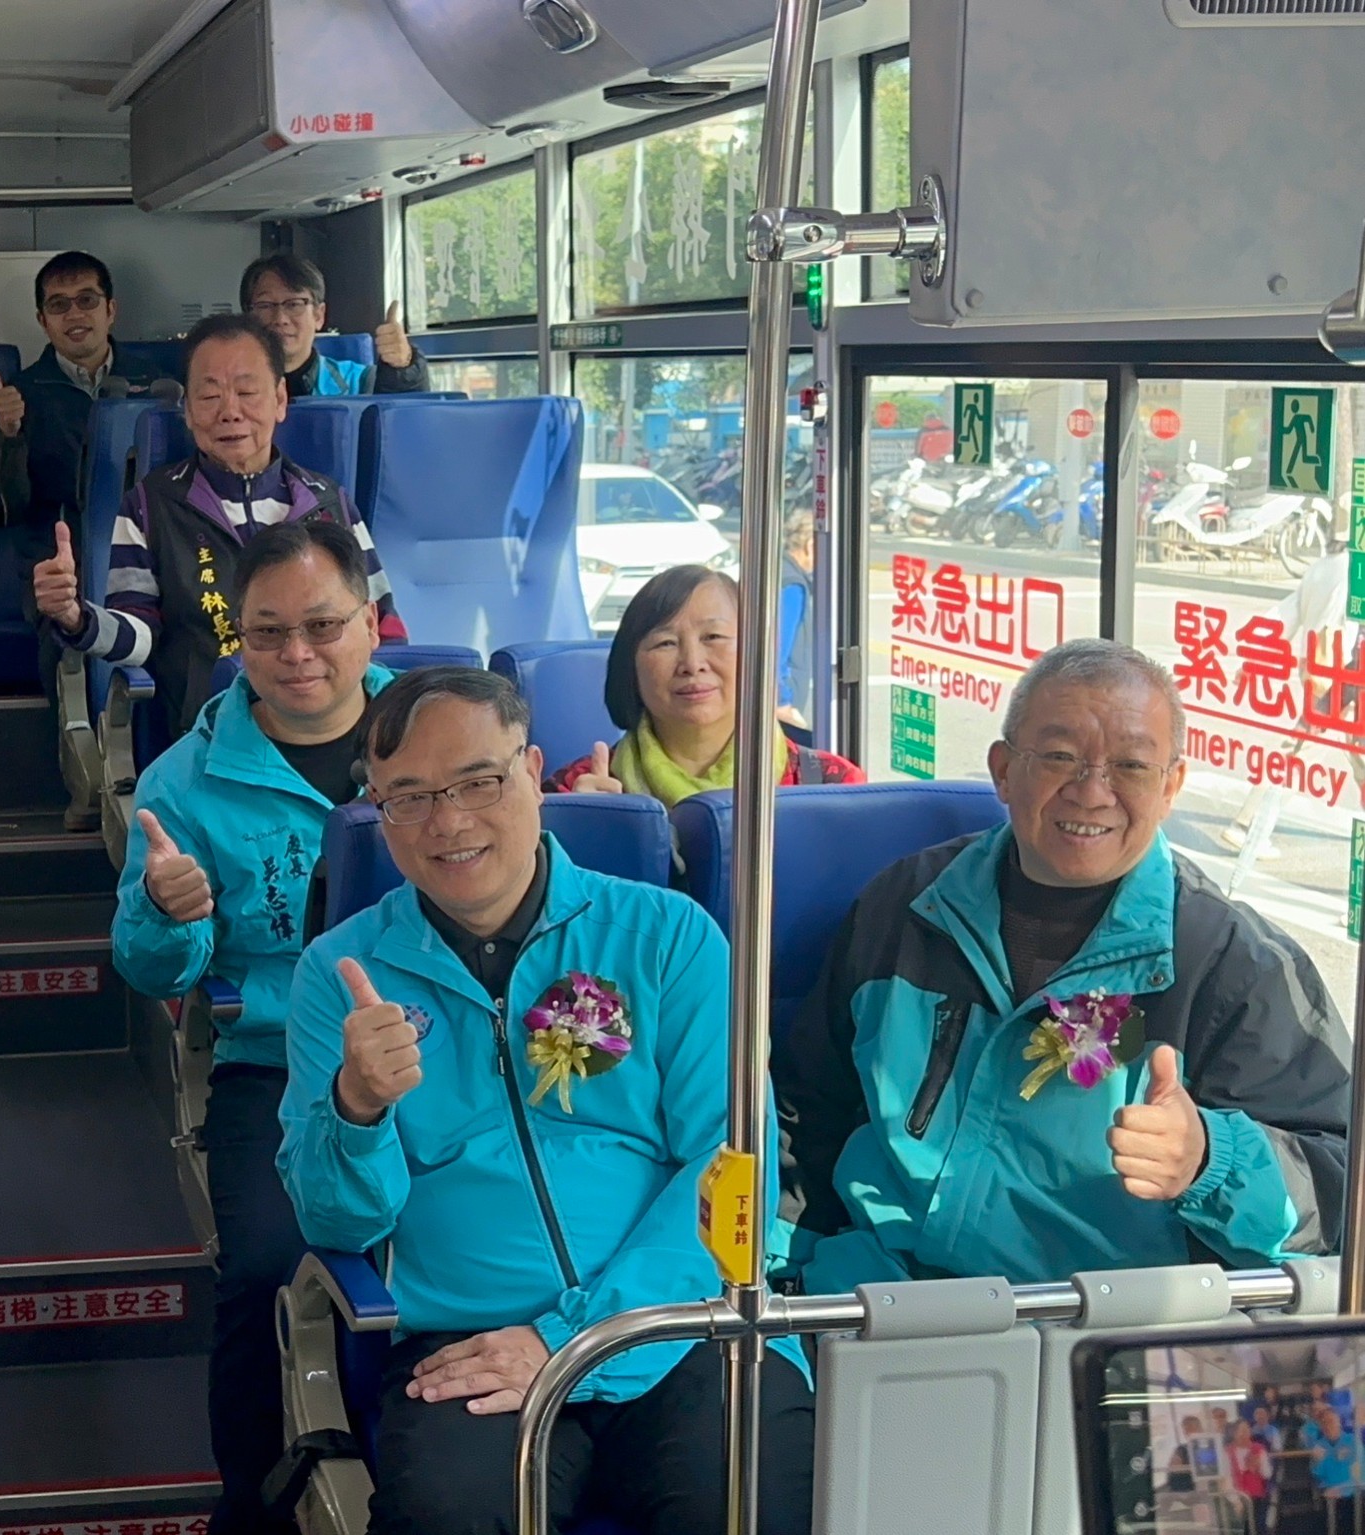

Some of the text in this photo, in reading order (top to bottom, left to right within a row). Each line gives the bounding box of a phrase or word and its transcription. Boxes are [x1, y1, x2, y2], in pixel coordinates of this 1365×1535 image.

[290, 113, 373, 134] 小心碰撞
[892, 554, 1064, 660] 緊急出口
[891, 645, 1002, 712] Emergency
[1173, 601, 1365, 736] 緊急出
[1181, 726, 1348, 807] mergency
[734, 1194, 749, 1246] 下車鈴
